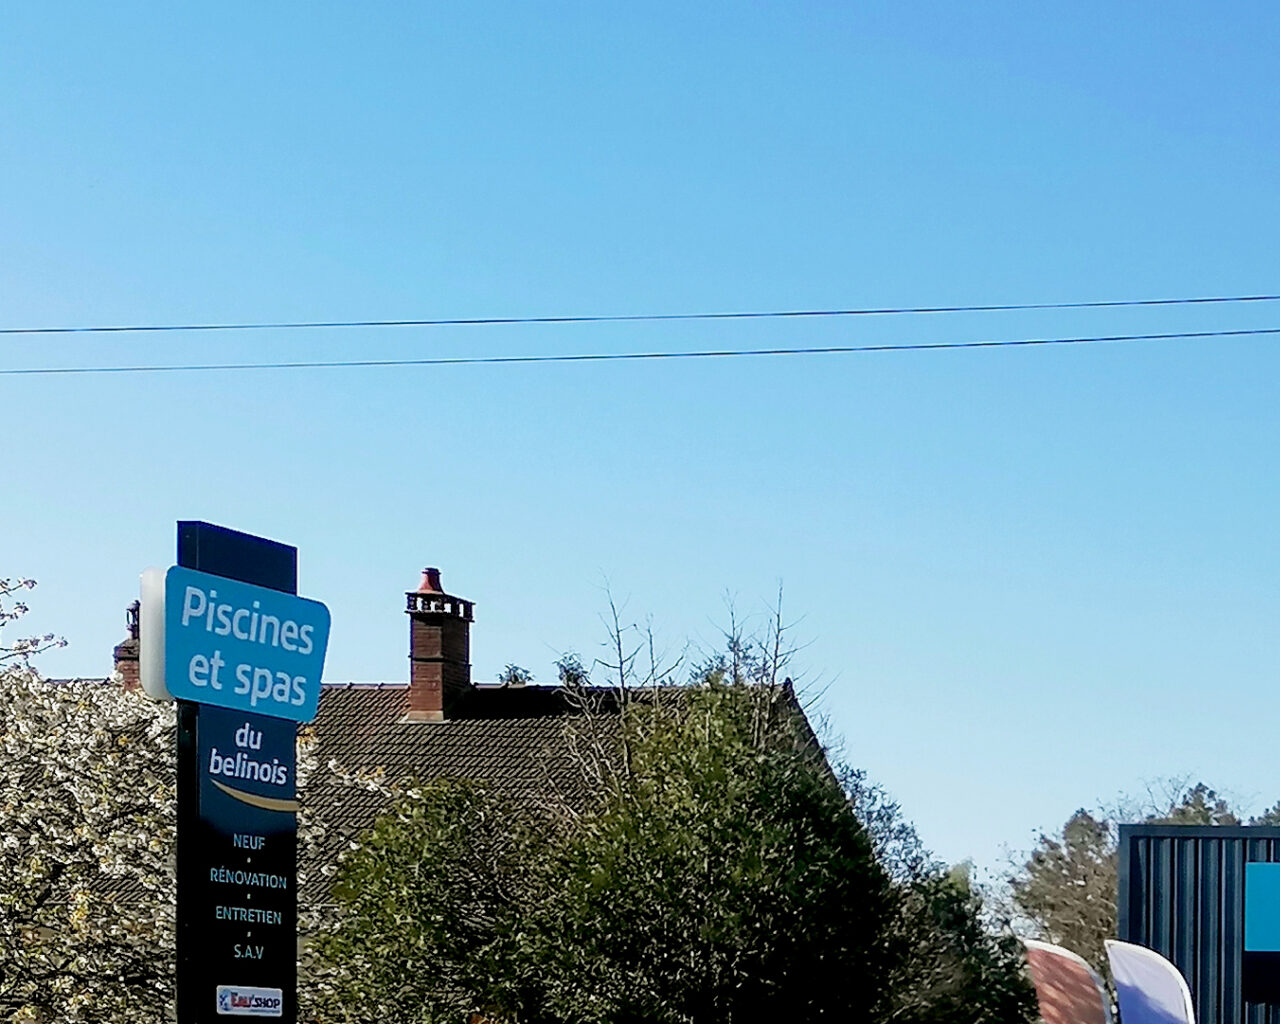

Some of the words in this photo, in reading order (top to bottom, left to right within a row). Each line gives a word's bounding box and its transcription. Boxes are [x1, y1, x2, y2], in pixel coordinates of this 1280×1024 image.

[181, 586, 313, 654] Piscines
[189, 650, 224, 690] et
[234, 661, 307, 707] spas
[235, 722, 262, 750] du
[209, 748, 288, 785] belinois
[233, 833, 265, 850] NEUF
[210, 866, 287, 889] RÉNOVATION
[215, 905, 282, 925] ENTRETIEN
[233, 944, 264, 960] S.A.V
